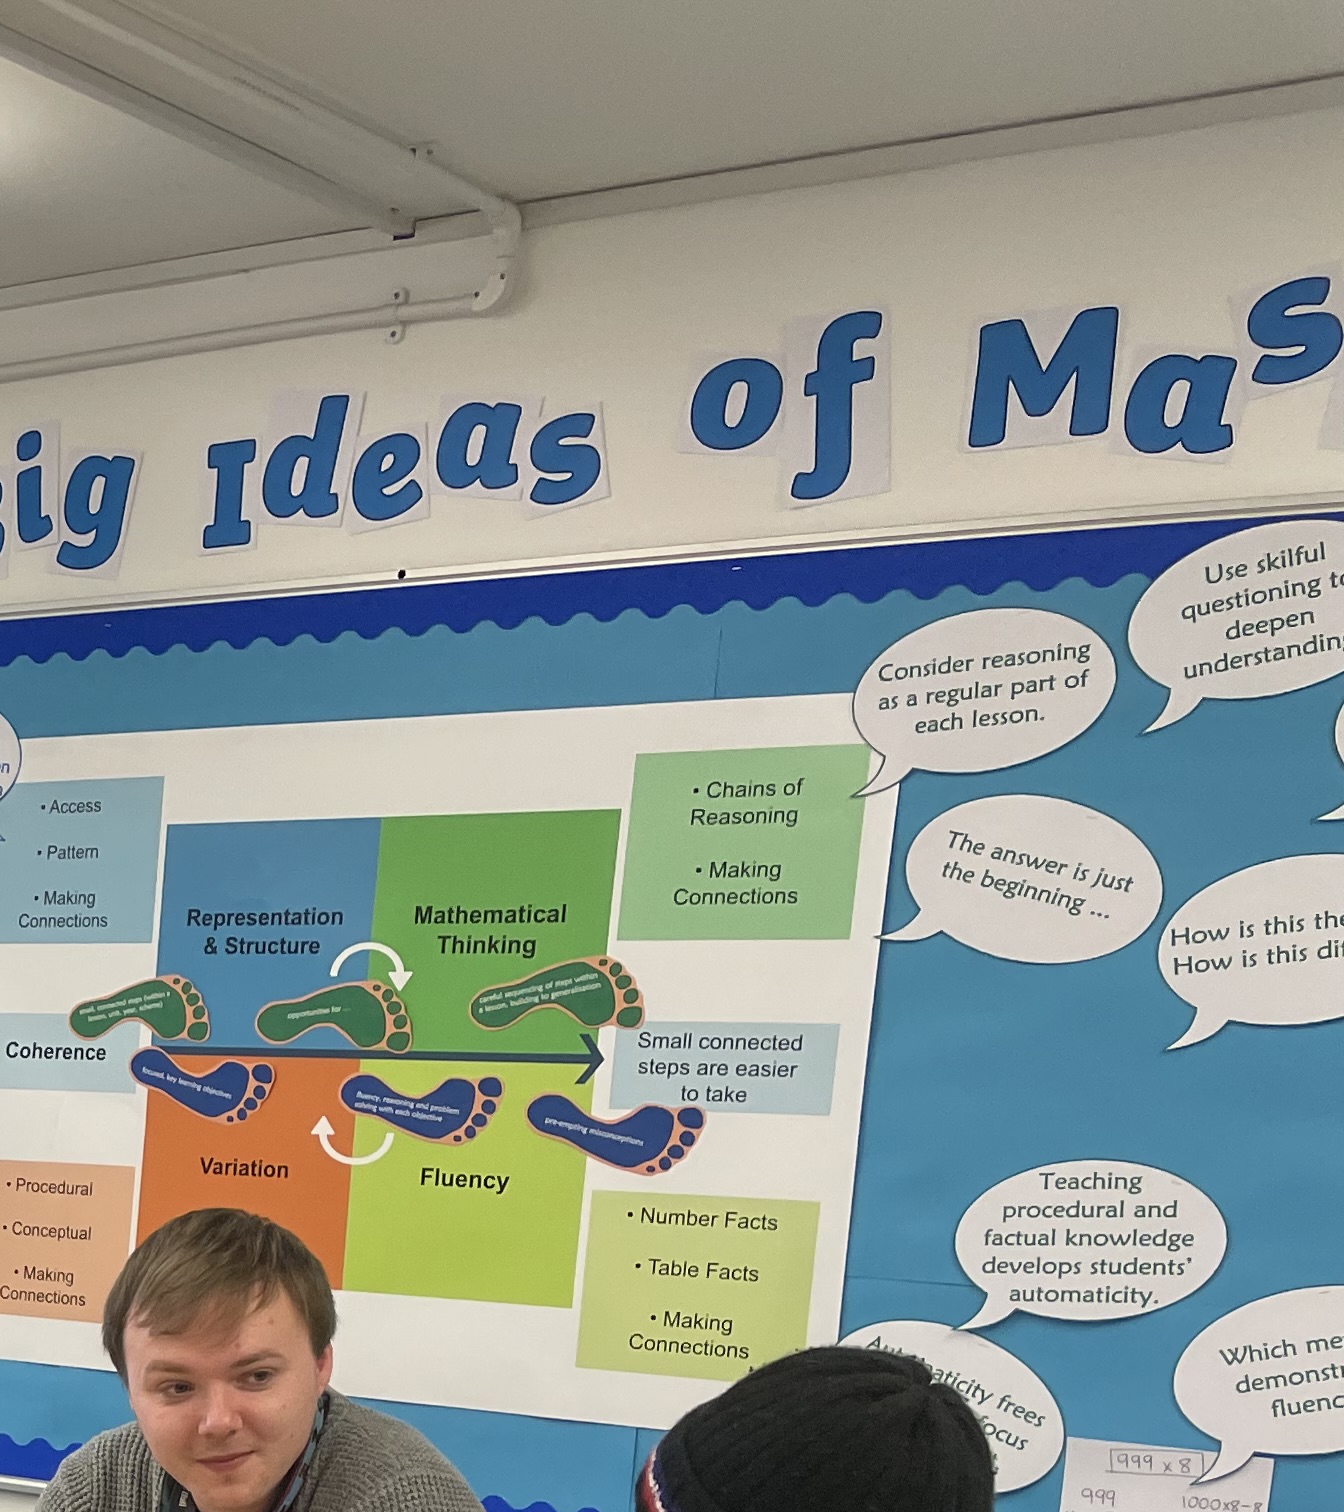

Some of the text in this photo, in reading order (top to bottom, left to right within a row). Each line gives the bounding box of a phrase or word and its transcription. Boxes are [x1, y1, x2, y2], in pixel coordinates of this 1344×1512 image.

[204, 394, 601, 550] Ideas
[690, 311, 882, 501] of
[1205, 541, 1326, 584] Use skilful
[1181, 577, 1322, 623] questioning
[1225, 610, 1315, 640] deepen
[879, 643, 1091, 682] Consider reasoning
[1184, 634, 1344, 679] understandin
[879, 669, 1090, 710] as a regular part of
[915, 708, 1045, 733] each lesson.
[707, 778, 805, 798] Chains of
[49, 799, 102, 814] Access
[691, 806, 798, 827] Reasoning
[47, 845, 99, 860] Pattern
[949, 830, 1134, 893] The answer is just
[710, 860, 781, 881] Making
[44, 891, 96, 908] Making
[674, 887, 798, 905] Connections
[942, 862, 975, 883] the
[981, 869, 1086, 916] beginning
[19, 913, 108, 928] Connections
[187, 907, 343, 929] Representation
[415, 904, 566, 924] Mathematical
[1171, 915, 1305, 946] How is this
[204, 936, 320, 955] & Structure
[437, 935, 536, 958] Thinking
[1174, 944, 1307, 975] How is this
[6, 1041, 106, 1060] Coherence
[638, 1032, 803, 1050] Small connected
[638, 1060, 798, 1078] steps are easier
[682, 1086, 747, 1102] to take
[200, 1157, 289, 1178] Variation
[16, 1178, 93, 1196] Procedural
[421, 1167, 509, 1195] Fluency
[1039, 1172, 1142, 1194] Teaching
[641, 1207, 778, 1231] Number Facts
[1003, 1200, 1177, 1222] procedural and
[12, 1221, 91, 1241] Conceptual
[984, 1229, 1194, 1251] factual knowledge
[24, 1266, 74, 1287] Making
[648, 1258, 759, 1282] Table Facts
[982, 1257, 1081, 1279] develops
[0, 1285, 86, 1306] Connections
[1009, 1286, 1159, 1308] automaticity.
[664, 1311, 733, 1336] Making
[629, 1333, 749, 1359] Connections
[1219, 1339, 1297, 1366] Which
[997, 1395, 1045, 1427] frees
[1117, 1453, 1153, 1469] 999
[1179, 1458, 1192, 1473] 8
[1081, 1488, 1116, 1507] 999
